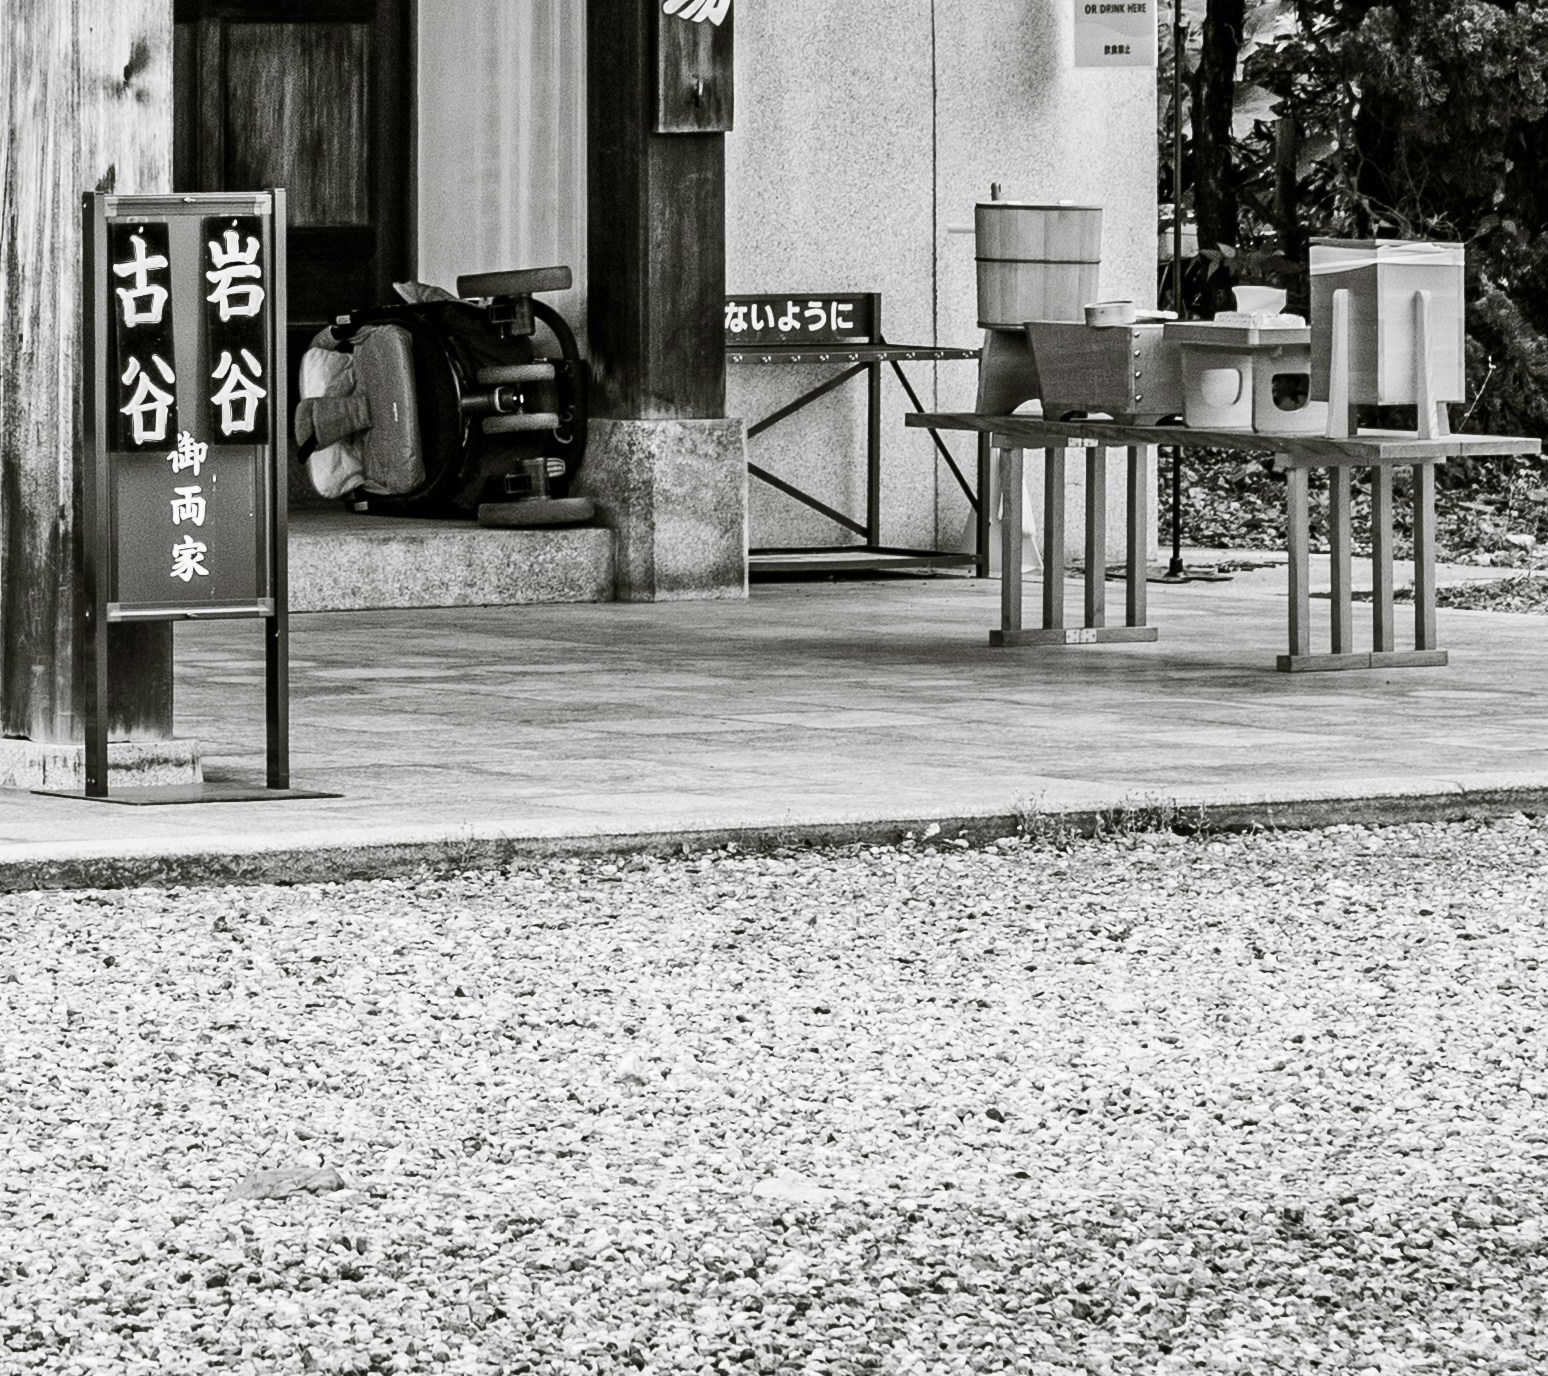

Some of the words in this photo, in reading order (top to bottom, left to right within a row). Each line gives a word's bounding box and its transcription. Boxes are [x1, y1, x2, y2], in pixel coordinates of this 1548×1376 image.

[1084, 4, 1097, 14] OR
[1100, 4, 1125, 13] DRINK
[1127, 3, 1146, 13] HERE
[113, 235, 176, 445] 古谷
[205, 230, 266, 435] 岩谷
[725, 301, 853, 333] ないように
[167, 430, 210, 582] 御両家
